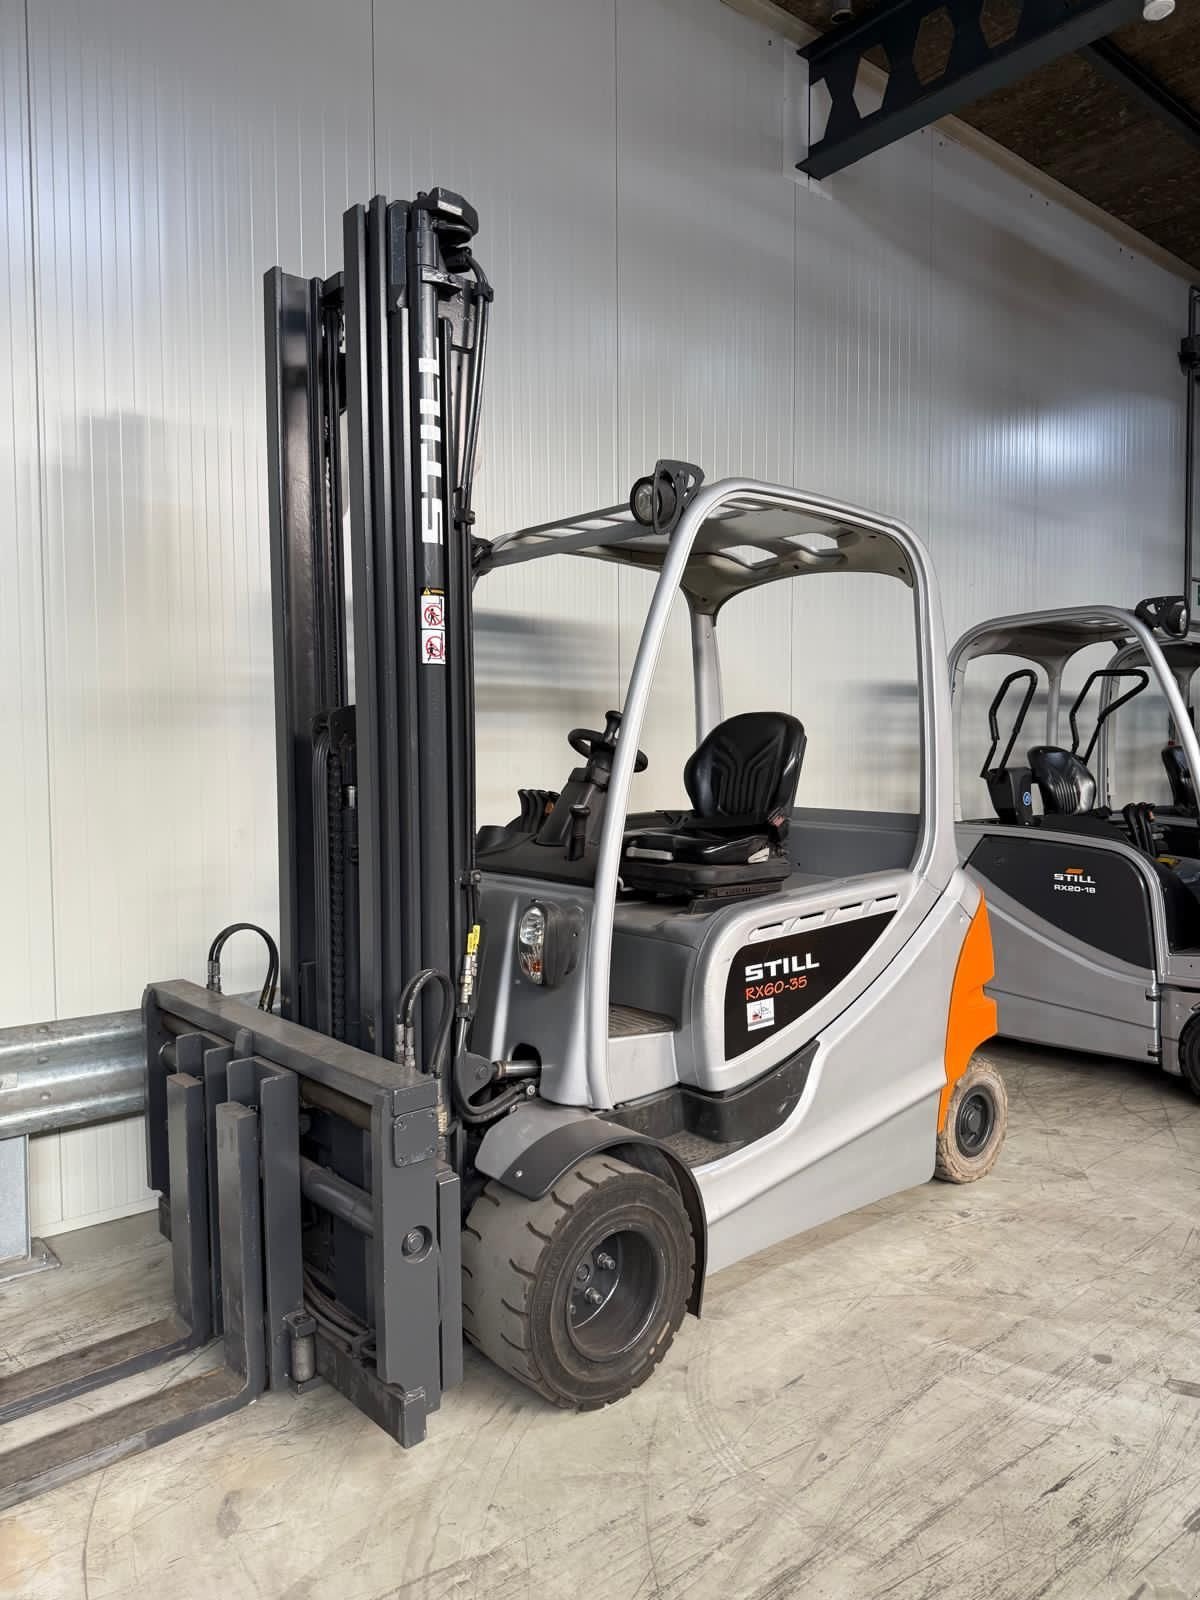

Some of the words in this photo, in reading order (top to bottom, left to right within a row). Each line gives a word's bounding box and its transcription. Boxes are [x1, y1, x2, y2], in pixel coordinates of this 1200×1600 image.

[418, 337, 443, 545] STILL
[1053, 873, 1096, 884] STILL
[1053, 884, 1096, 894] RX20-18
[745, 952, 820, 983] STILL
[745, 975, 808, 1000] RX60-35
